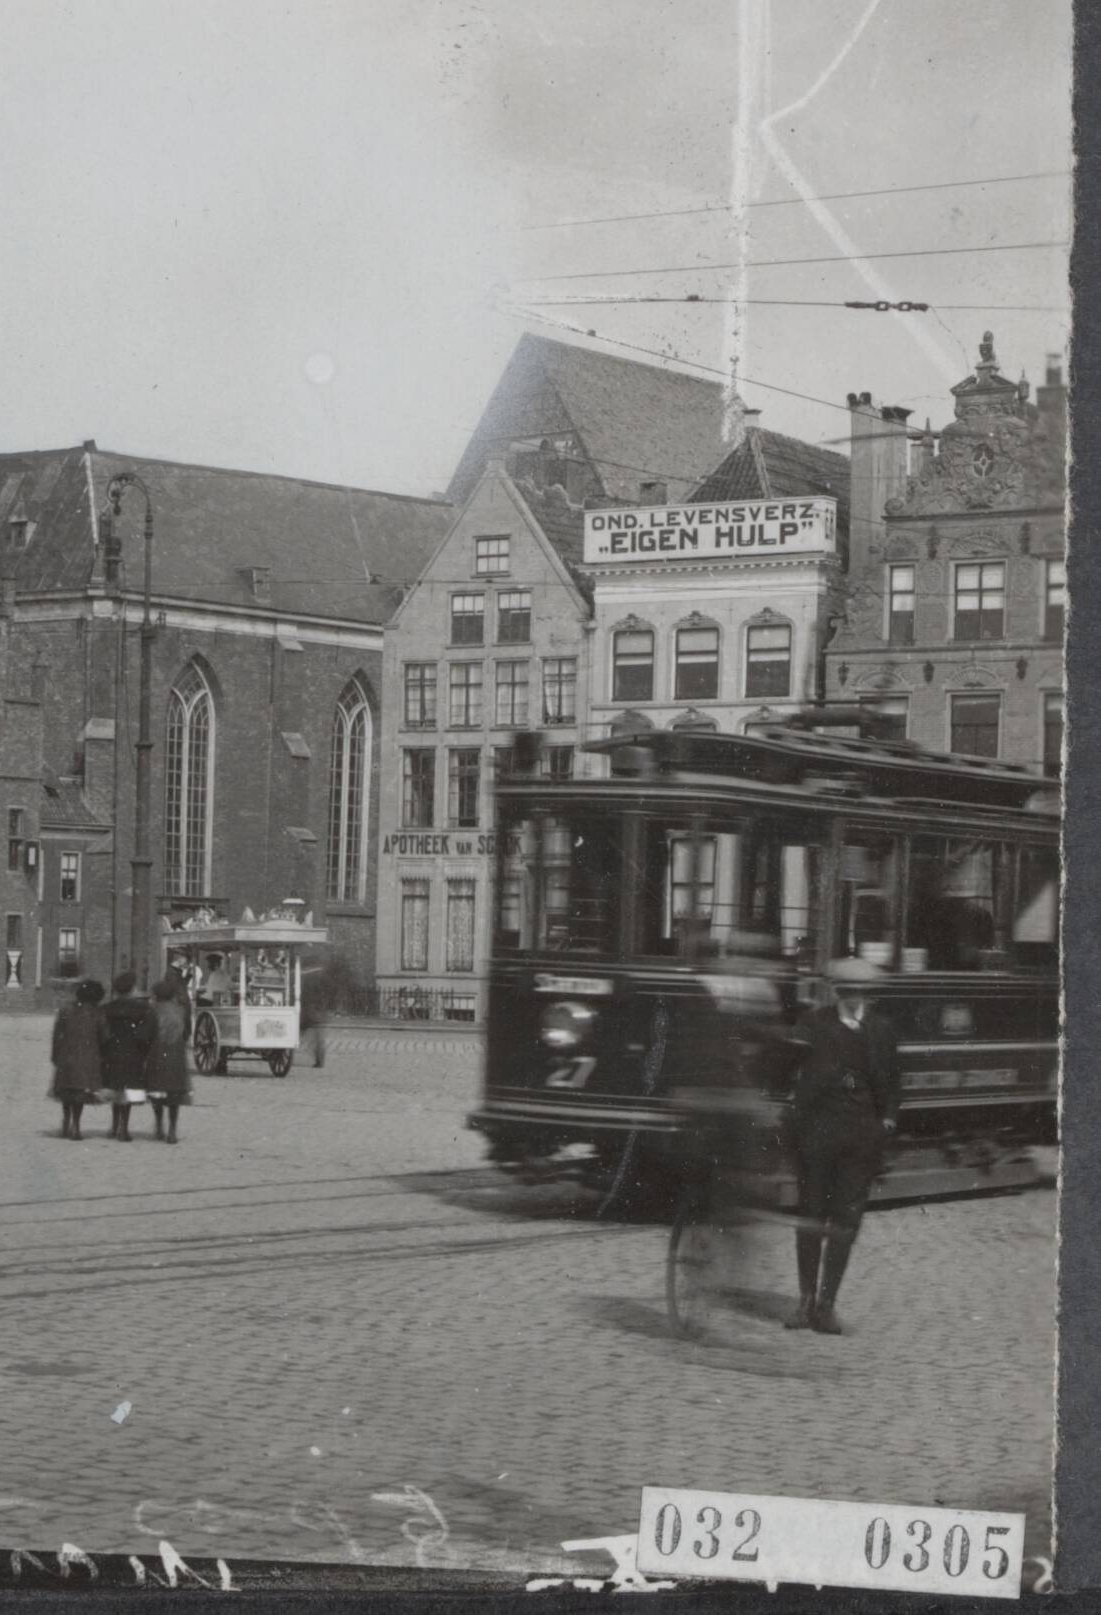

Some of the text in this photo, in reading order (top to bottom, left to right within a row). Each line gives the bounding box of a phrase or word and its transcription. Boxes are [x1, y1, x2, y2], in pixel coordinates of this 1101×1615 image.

[591, 514, 644, 531] OND.
[650, 503, 821, 528] LEVENSVERZ.
[382, 834, 450, 855] APOTHEEK
